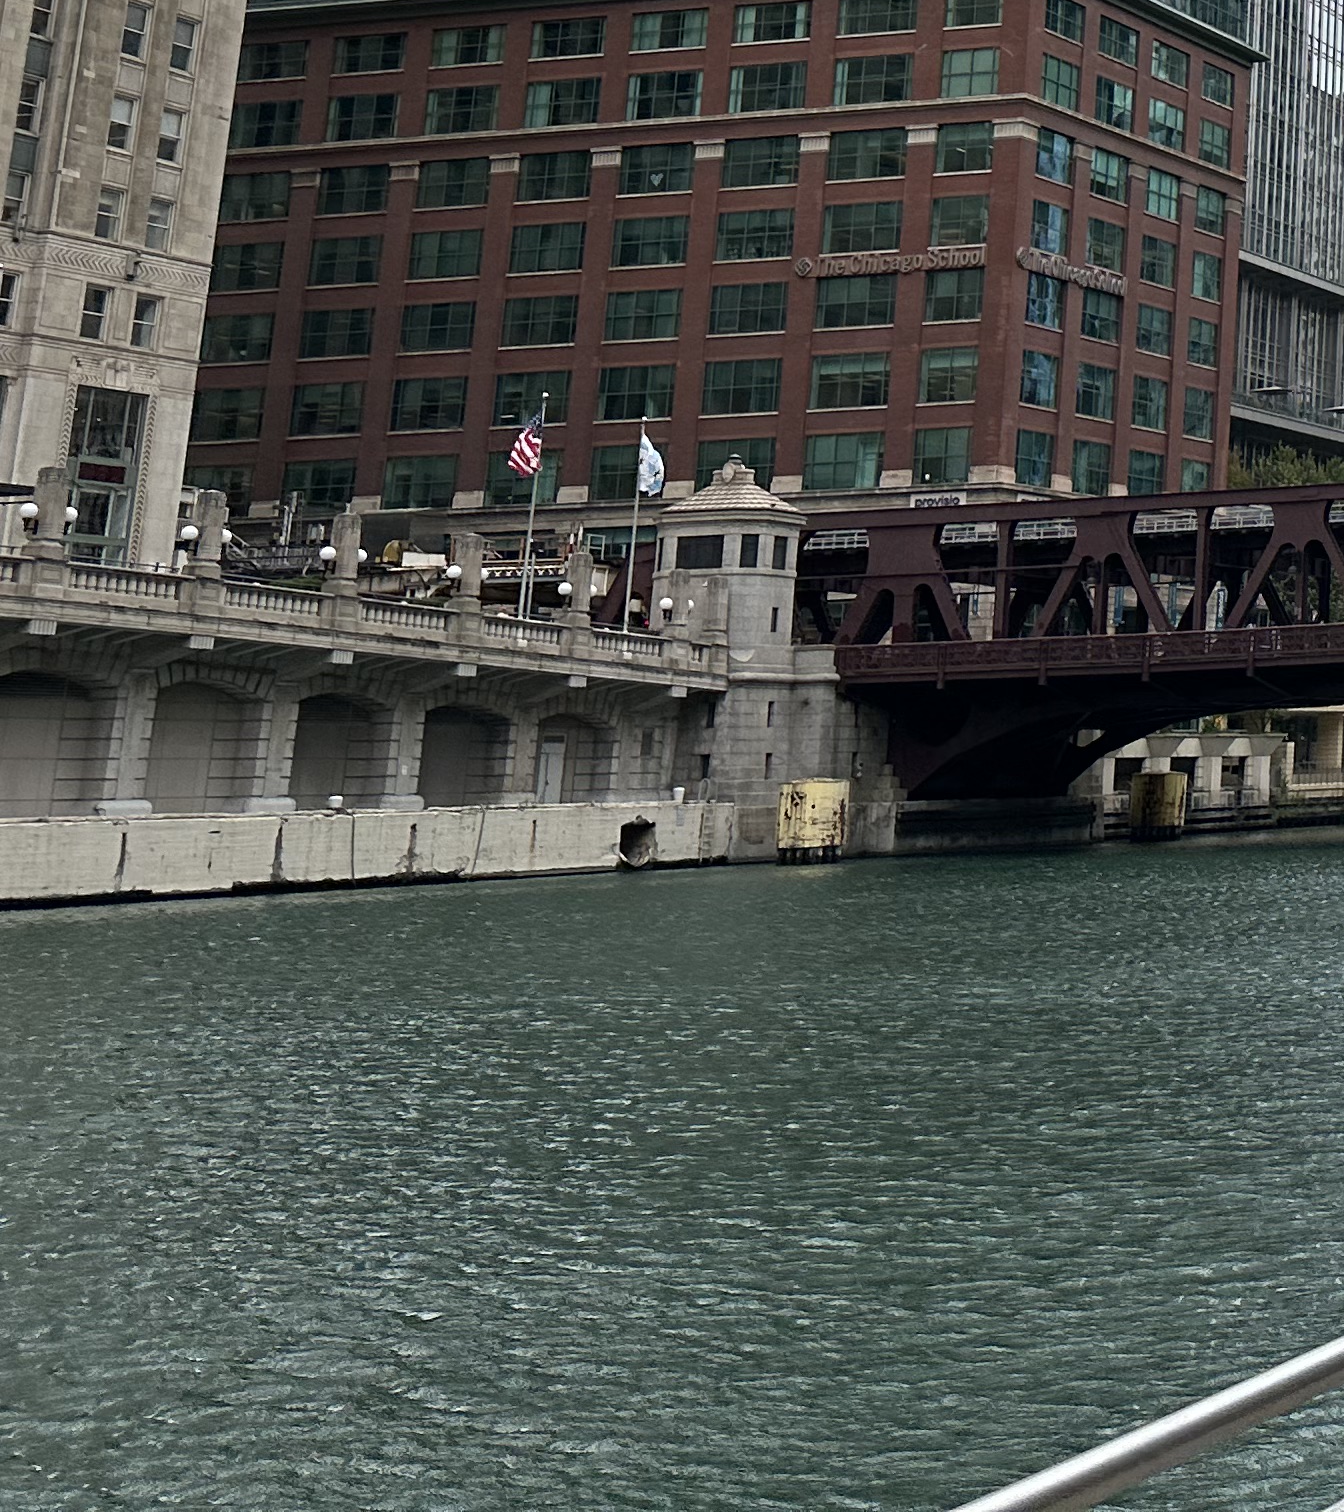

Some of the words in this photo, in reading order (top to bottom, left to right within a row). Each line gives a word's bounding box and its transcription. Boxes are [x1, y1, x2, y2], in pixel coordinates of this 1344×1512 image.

[814, 257, 846, 275] The
[850, 252, 923, 273] Chicago
[927, 246, 985, 268] School
